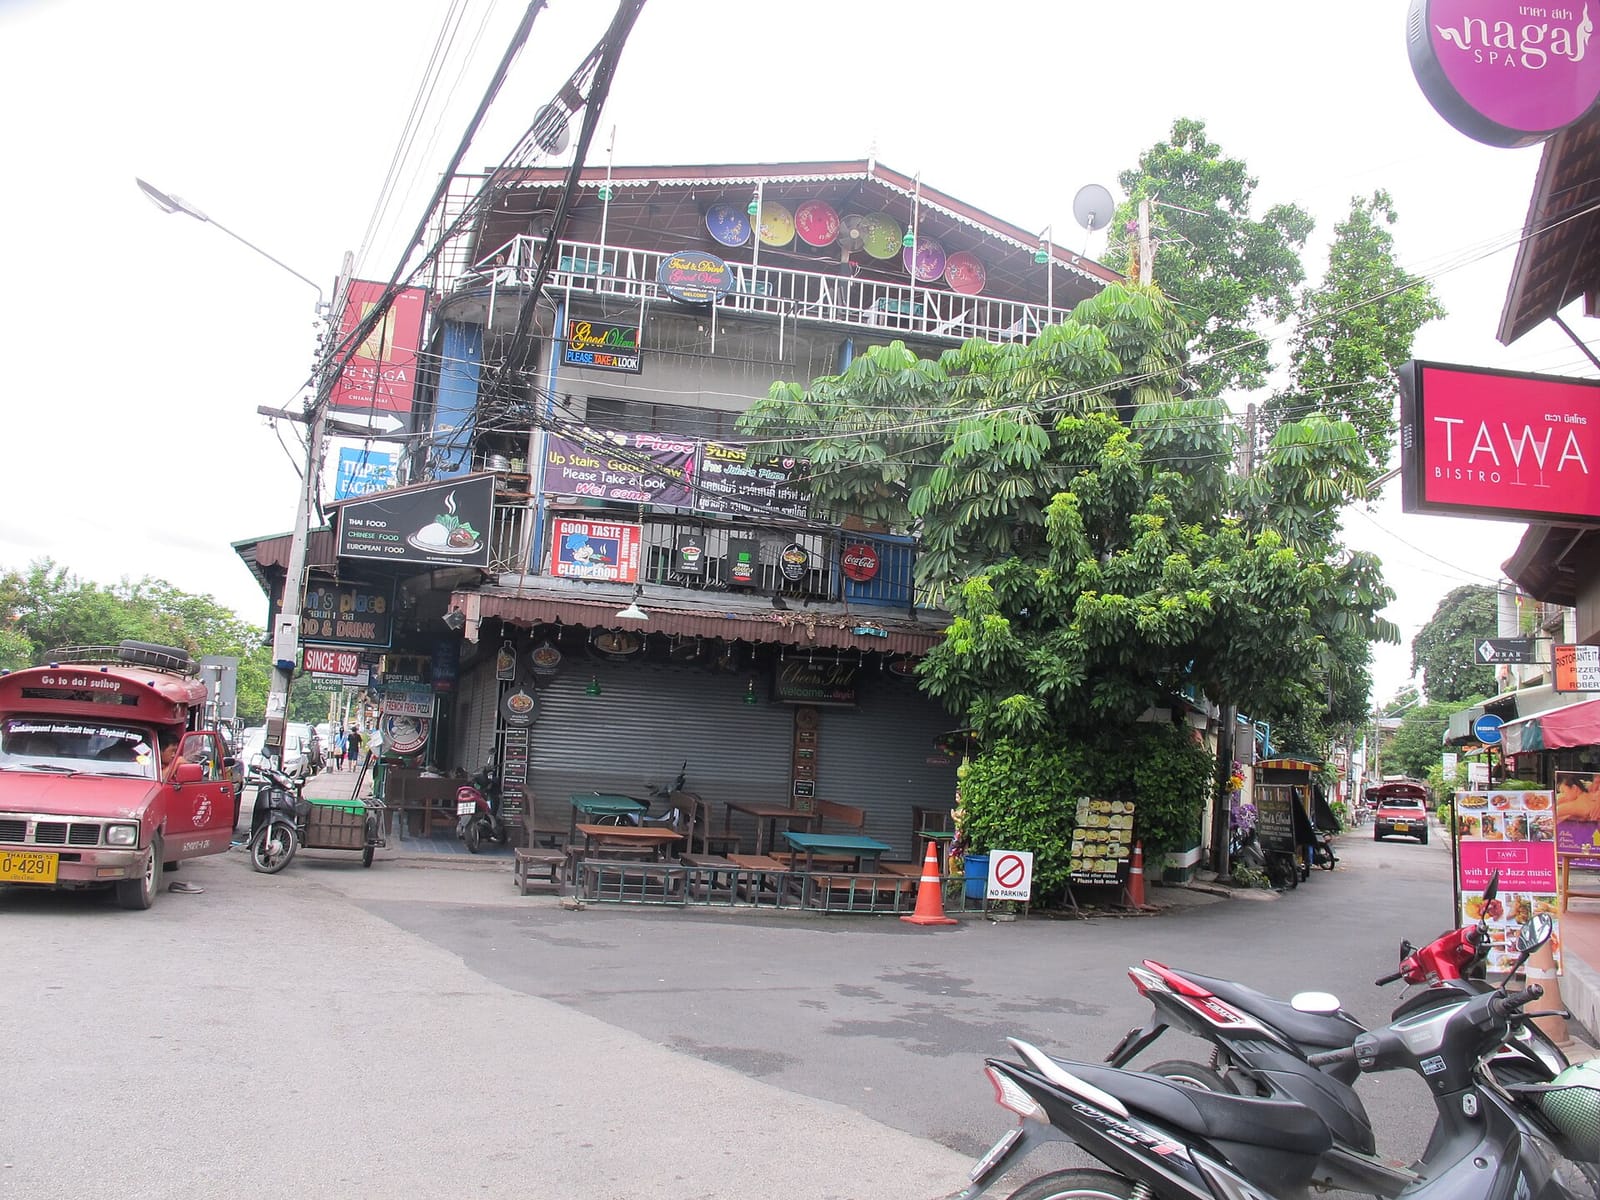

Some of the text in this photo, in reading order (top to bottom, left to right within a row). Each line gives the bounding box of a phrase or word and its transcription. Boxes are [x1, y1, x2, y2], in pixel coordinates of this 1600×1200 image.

[1474, 49, 1516, 68] SPA
[571, 320, 607, 350] Good
[566, 351, 638, 369] PLEASE TAKE A LOOK
[1434, 416, 1588, 474] TAWA
[550, 452, 565, 464] Up
[570, 455, 600, 468] Stairs
[563, 466, 666, 489] Please Take a Look
[1434, 466, 1500, 483] BISTRO
[348, 531, 399, 541] CHINESE FOOD
[560, 522, 621, 538] GOOD TASTE
[347, 544, 381, 552] EUROPEAN
[558, 564, 618, 579] CLEAN FOOD
[340, 589, 386, 614] place
[336, 620, 376, 639] DRINK
[306, 652, 358, 674] SINCE 1992
[42, 676, 120, 690] Go to doi suthep
[1464, 868, 1482, 876] with
[1506, 868, 1525, 876] Jazz
[1527, 868, 1552, 877] music
[1001, 890, 1028, 898] PARKING
